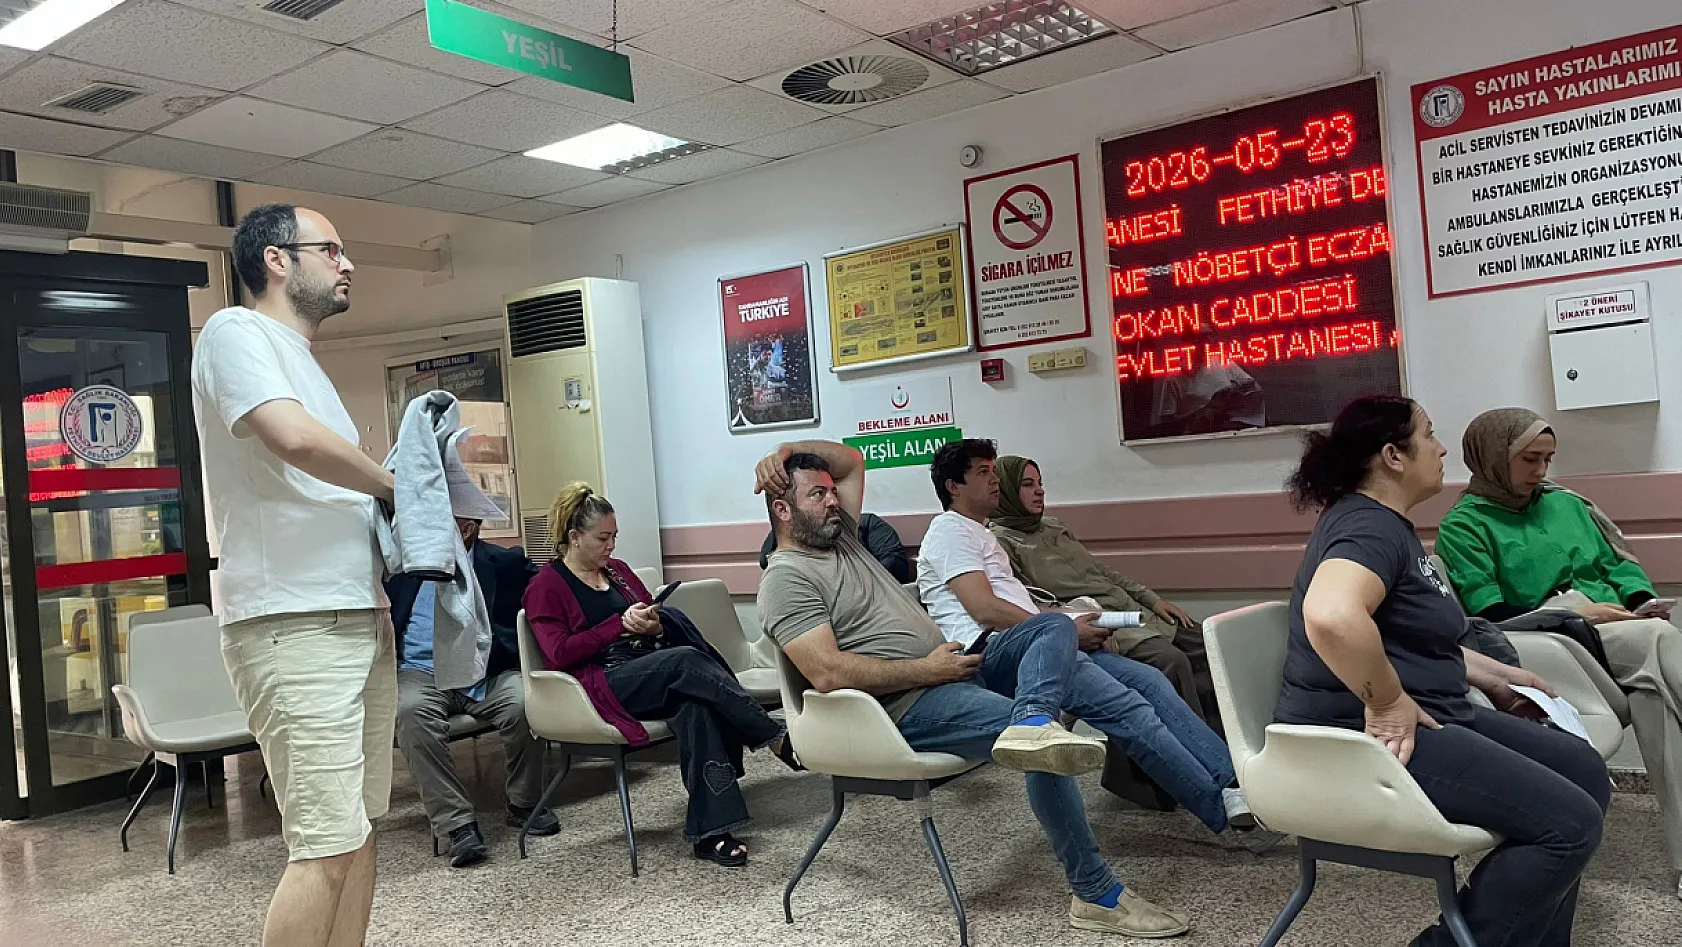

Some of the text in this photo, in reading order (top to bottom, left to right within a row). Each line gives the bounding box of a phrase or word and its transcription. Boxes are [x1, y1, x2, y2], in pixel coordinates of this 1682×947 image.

[502, 30, 572, 71] YEŞİL
[1475, 38, 1678, 96] SAYIN HASTALARIMIZ
[1488, 89, 1549, 115] HASTA
[1439, 97, 1682, 159] ACİL SERVİSTEN TEDAVİNİZİN DEVAMI
[1125, 114, 1354, 195] 2026-05-23
[1432, 167, 1453, 185] BİR
[1456, 154, 1530, 180] HASTANEYE
[1534, 140, 1595, 165] SEVKİNİZ
[1218, 176, 1344, 225] FETHİYE
[1447, 176, 1682, 232] AMBULANSLARIMIZLA GERÇEKLEŞT
[1472, 171, 1567, 202] HASTANEMİZİN
[1438, 238, 1483, 258] SAĞLIK
[1486, 221, 1578, 250] GÜVENLİĞİNİZ
[1582, 216, 1609, 238] İÇİN
[1613, 209, 1665, 230] LÜTFEN
[981, 251, 1073, 282] SİGARA İÇİLMEZ
[1113, 268, 1149, 296] NE
[1173, 235, 1301, 287] NÖBETÇİ
[1308, 224, 1390, 263] ECZA
[1478, 254, 1517, 276] KENDİ
[1520, 243, 1616, 271] İMKANLARINIZ
[1620, 239, 1641, 256] İLE
[1115, 273, 1358, 340] OKAN CADDESİ
[1560, 304, 1633, 321] ŞİKAYET KUTUSU
[858, 412, 950, 431] BEKLEME ALANI
[859, 437, 947, 463] YEŞİL ALAN
